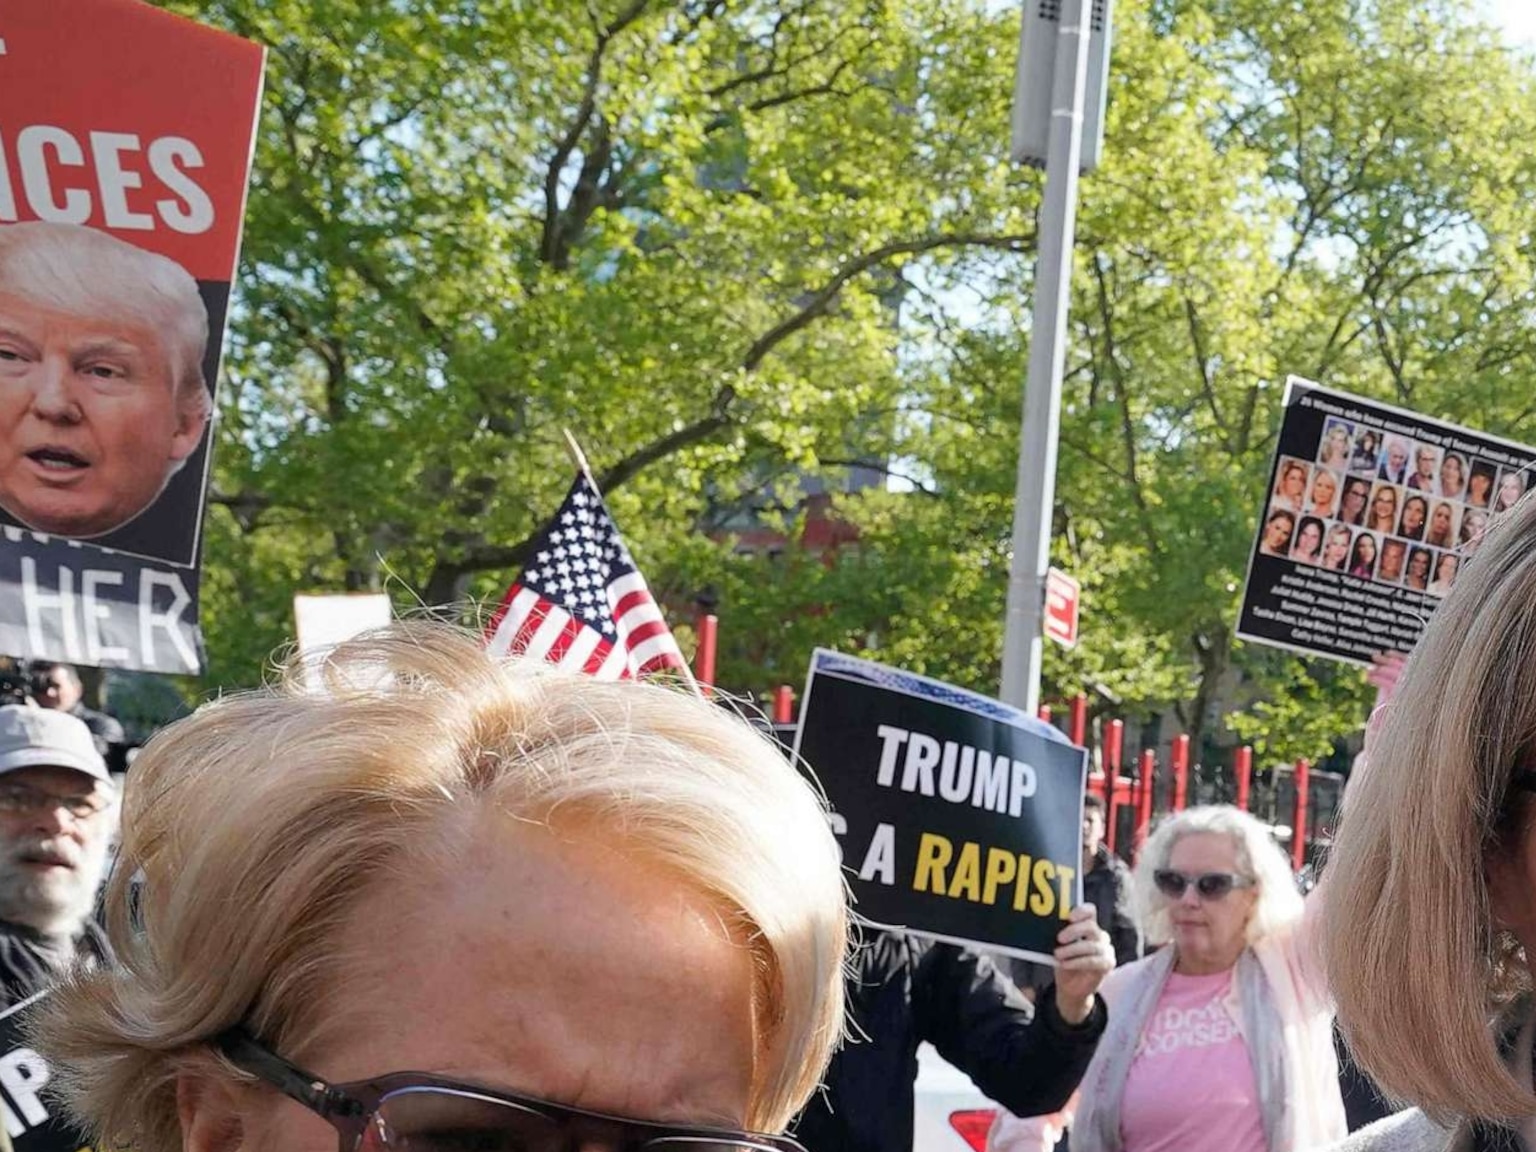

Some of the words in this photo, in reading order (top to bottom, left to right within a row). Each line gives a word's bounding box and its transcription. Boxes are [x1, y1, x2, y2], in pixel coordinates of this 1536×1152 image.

[21, 556, 200, 671] HER
[876, 724, 1038, 818] TRUMP
[858, 821, 896, 886] A
[912, 832, 1075, 921] RAPIST
